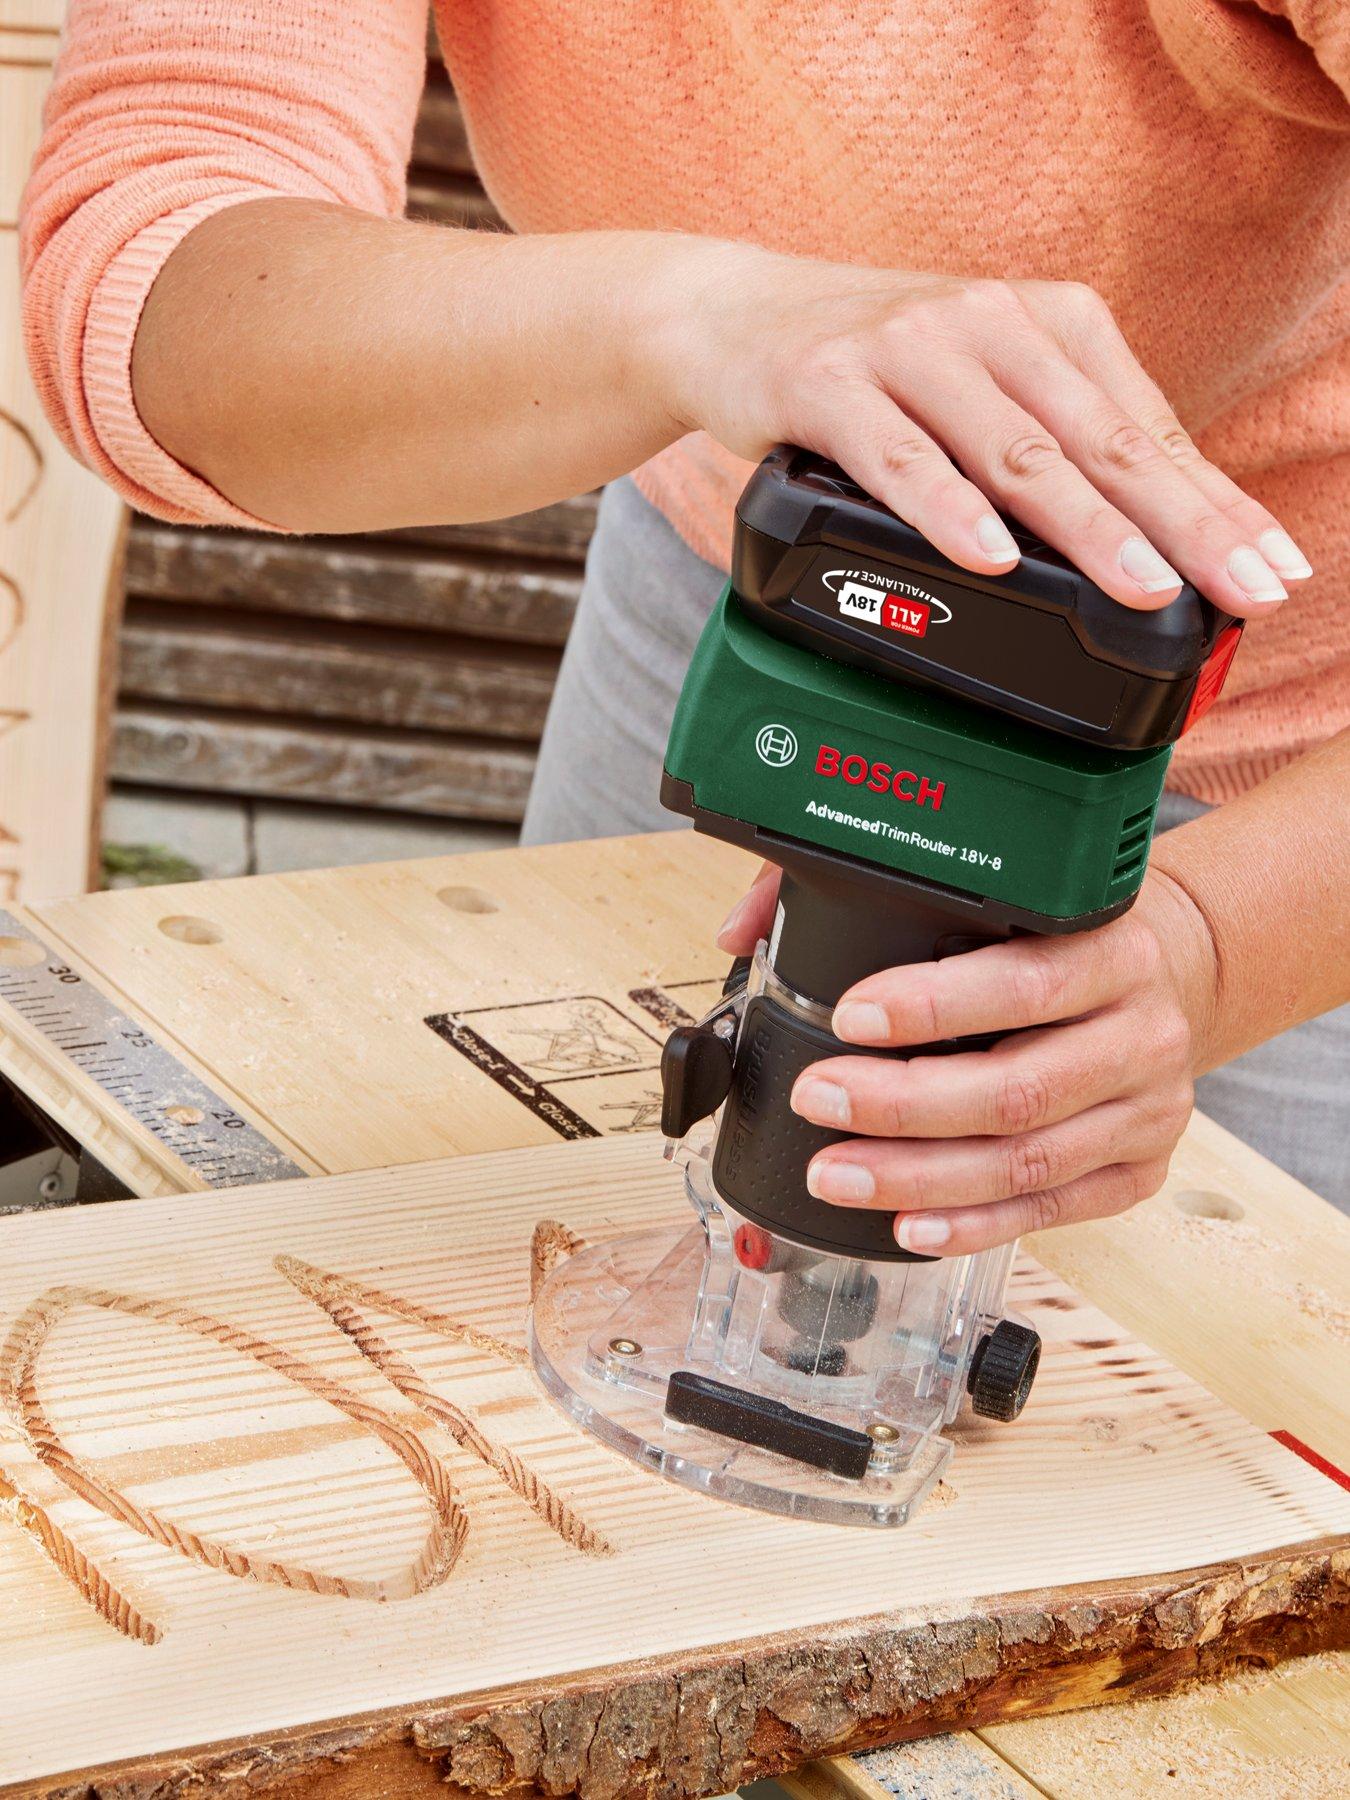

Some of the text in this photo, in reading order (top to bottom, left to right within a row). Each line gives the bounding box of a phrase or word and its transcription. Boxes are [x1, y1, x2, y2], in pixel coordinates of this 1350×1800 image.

[860, 570, 920, 596] ALLIANCE
[845, 593, 878, 613] 18V
[888, 604, 922, 626] ALL
[814, 744, 946, 811] BOSCH
[805, 800, 1003, 871] AdvancedTrimRouter 18V-8
[48, 965, 81, 984] 30
[120, 1030, 154, 1049] 25
[211, 1109, 246, 1130] 20
